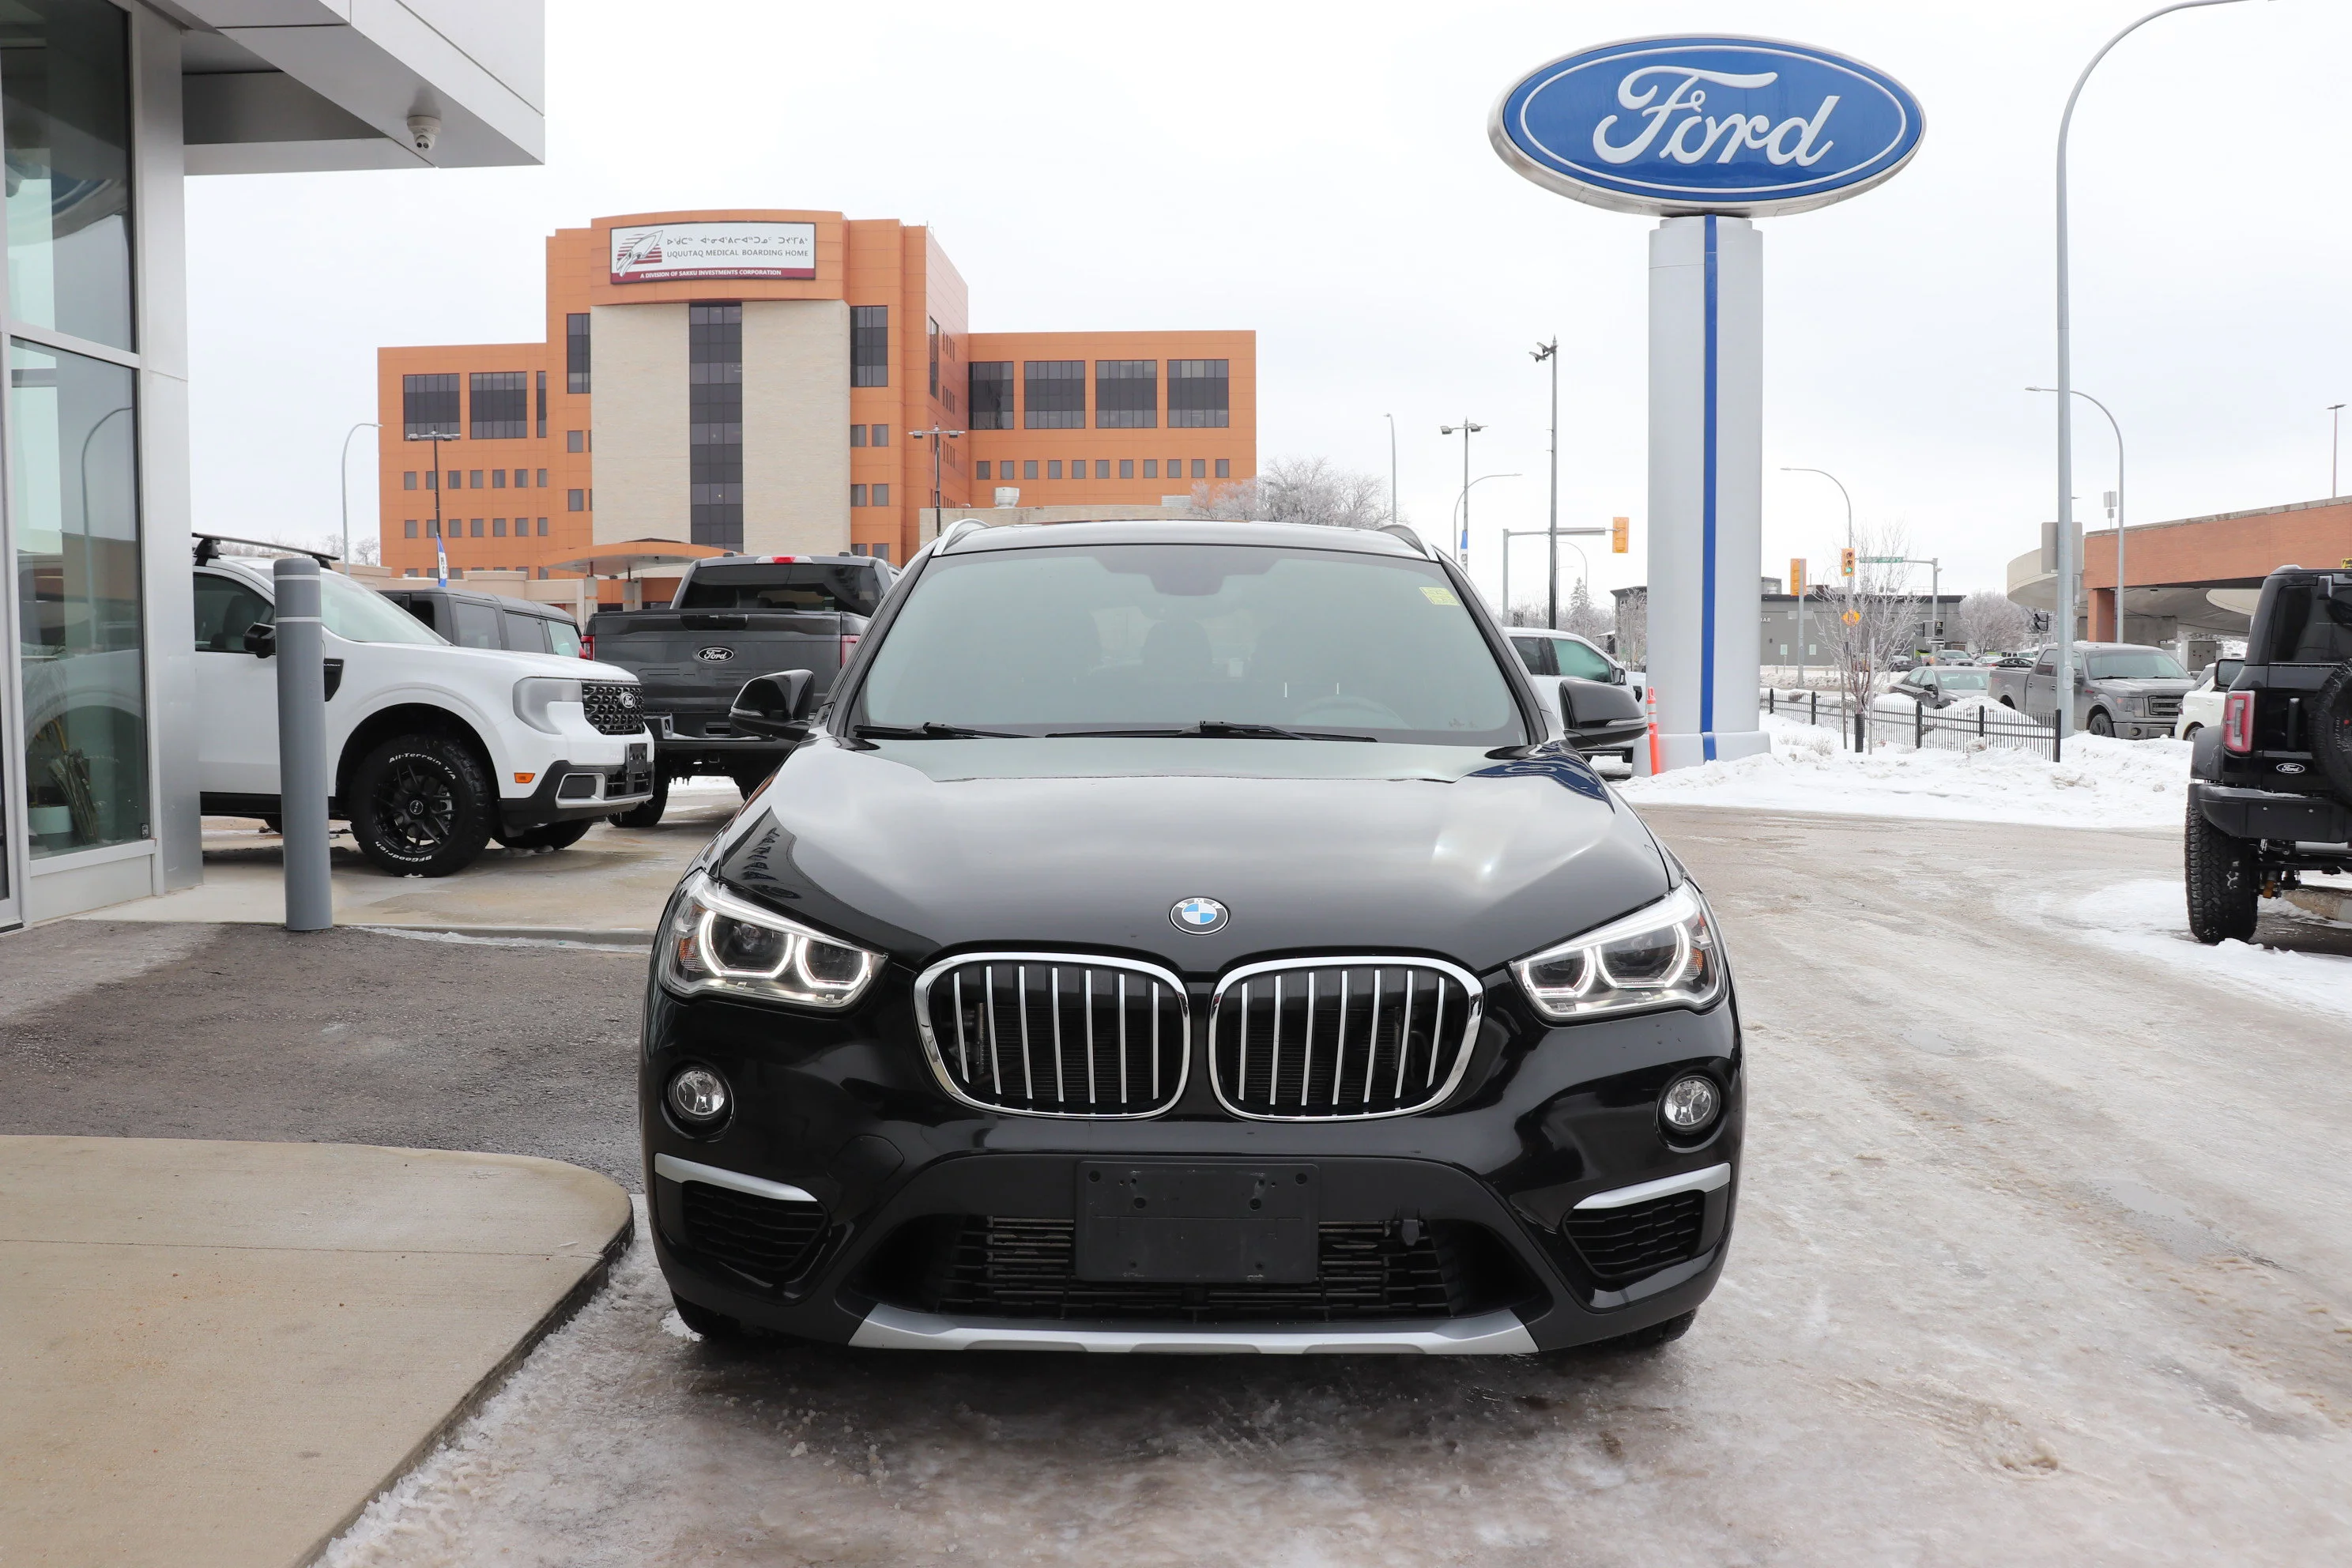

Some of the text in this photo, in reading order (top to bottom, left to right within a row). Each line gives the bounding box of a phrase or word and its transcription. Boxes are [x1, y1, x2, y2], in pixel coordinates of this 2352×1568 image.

[1592, 66, 1841, 167] Ford
[703, 649, 728, 660] Ford
[624, 695, 634, 706] Ford
[388, 752, 456, 780] All-Terrain T/A
[375, 841, 432, 862] BFGoodrich
[1176, 899, 1223, 909] BMW
